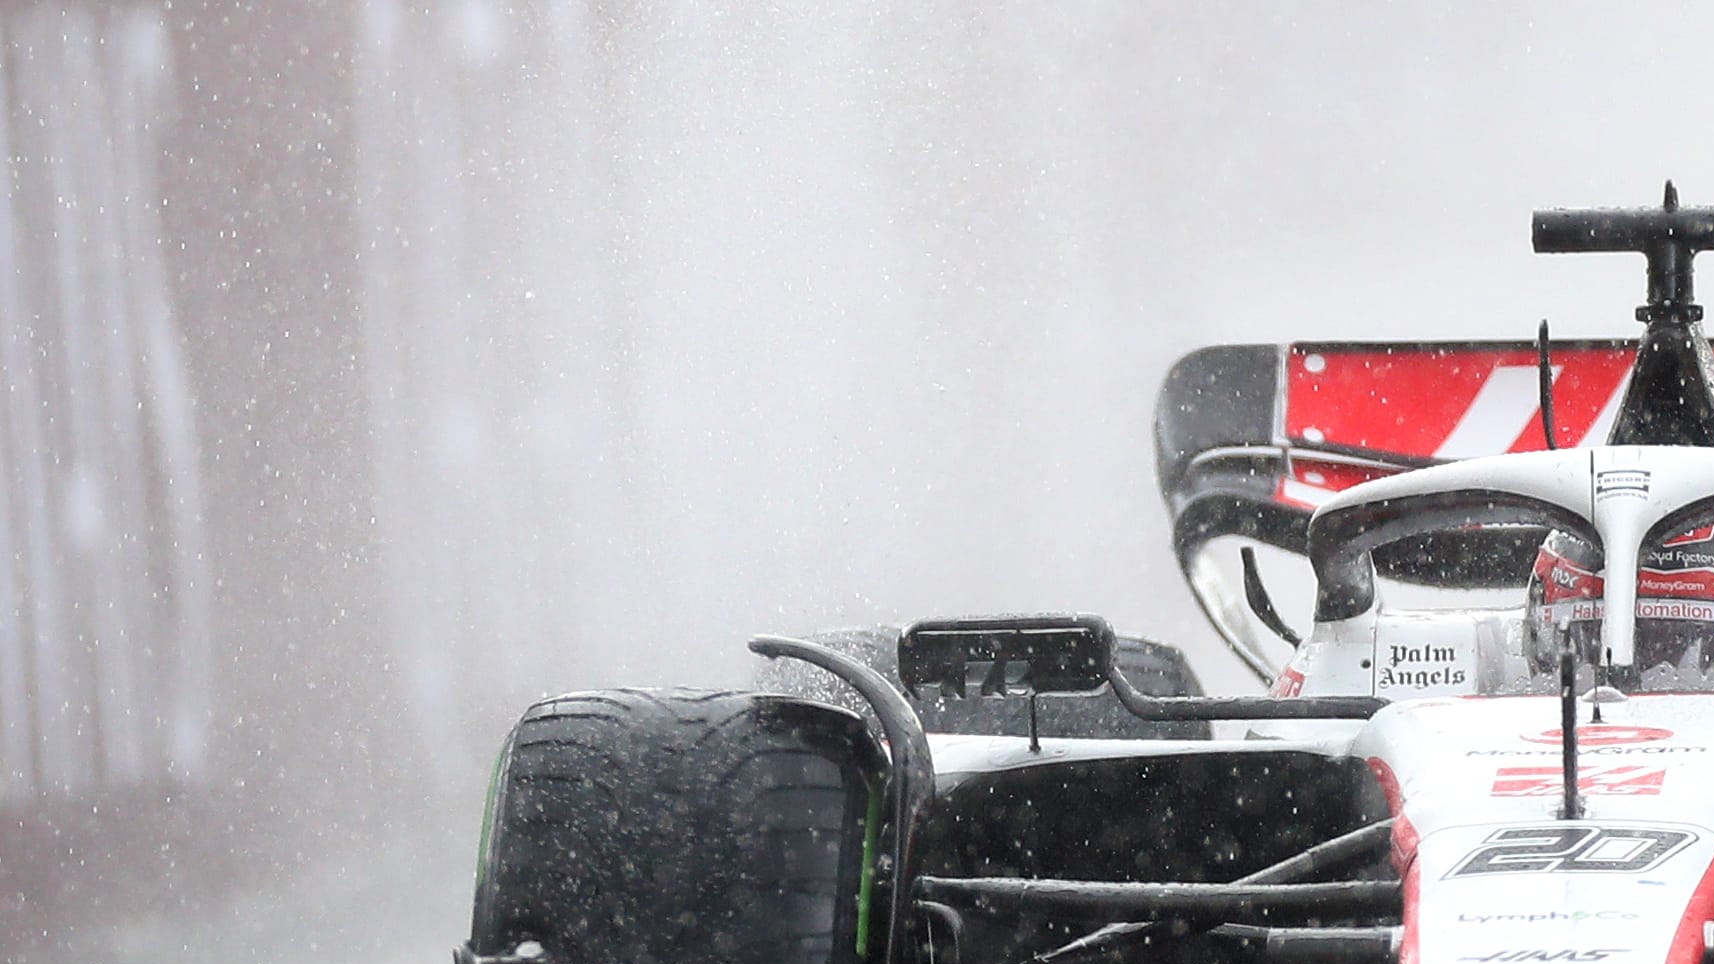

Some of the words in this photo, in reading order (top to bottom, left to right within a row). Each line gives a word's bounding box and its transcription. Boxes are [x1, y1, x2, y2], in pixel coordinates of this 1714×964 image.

[1641, 579, 1705, 592] MoneyGram
[1637, 603, 1713, 619] tomation
[1389, 644, 1456, 667] Palm
[1379, 667, 1466, 688] Angels
[1439, 826, 1700, 881] 20
[1456, 949, 1633, 962] HAAS
